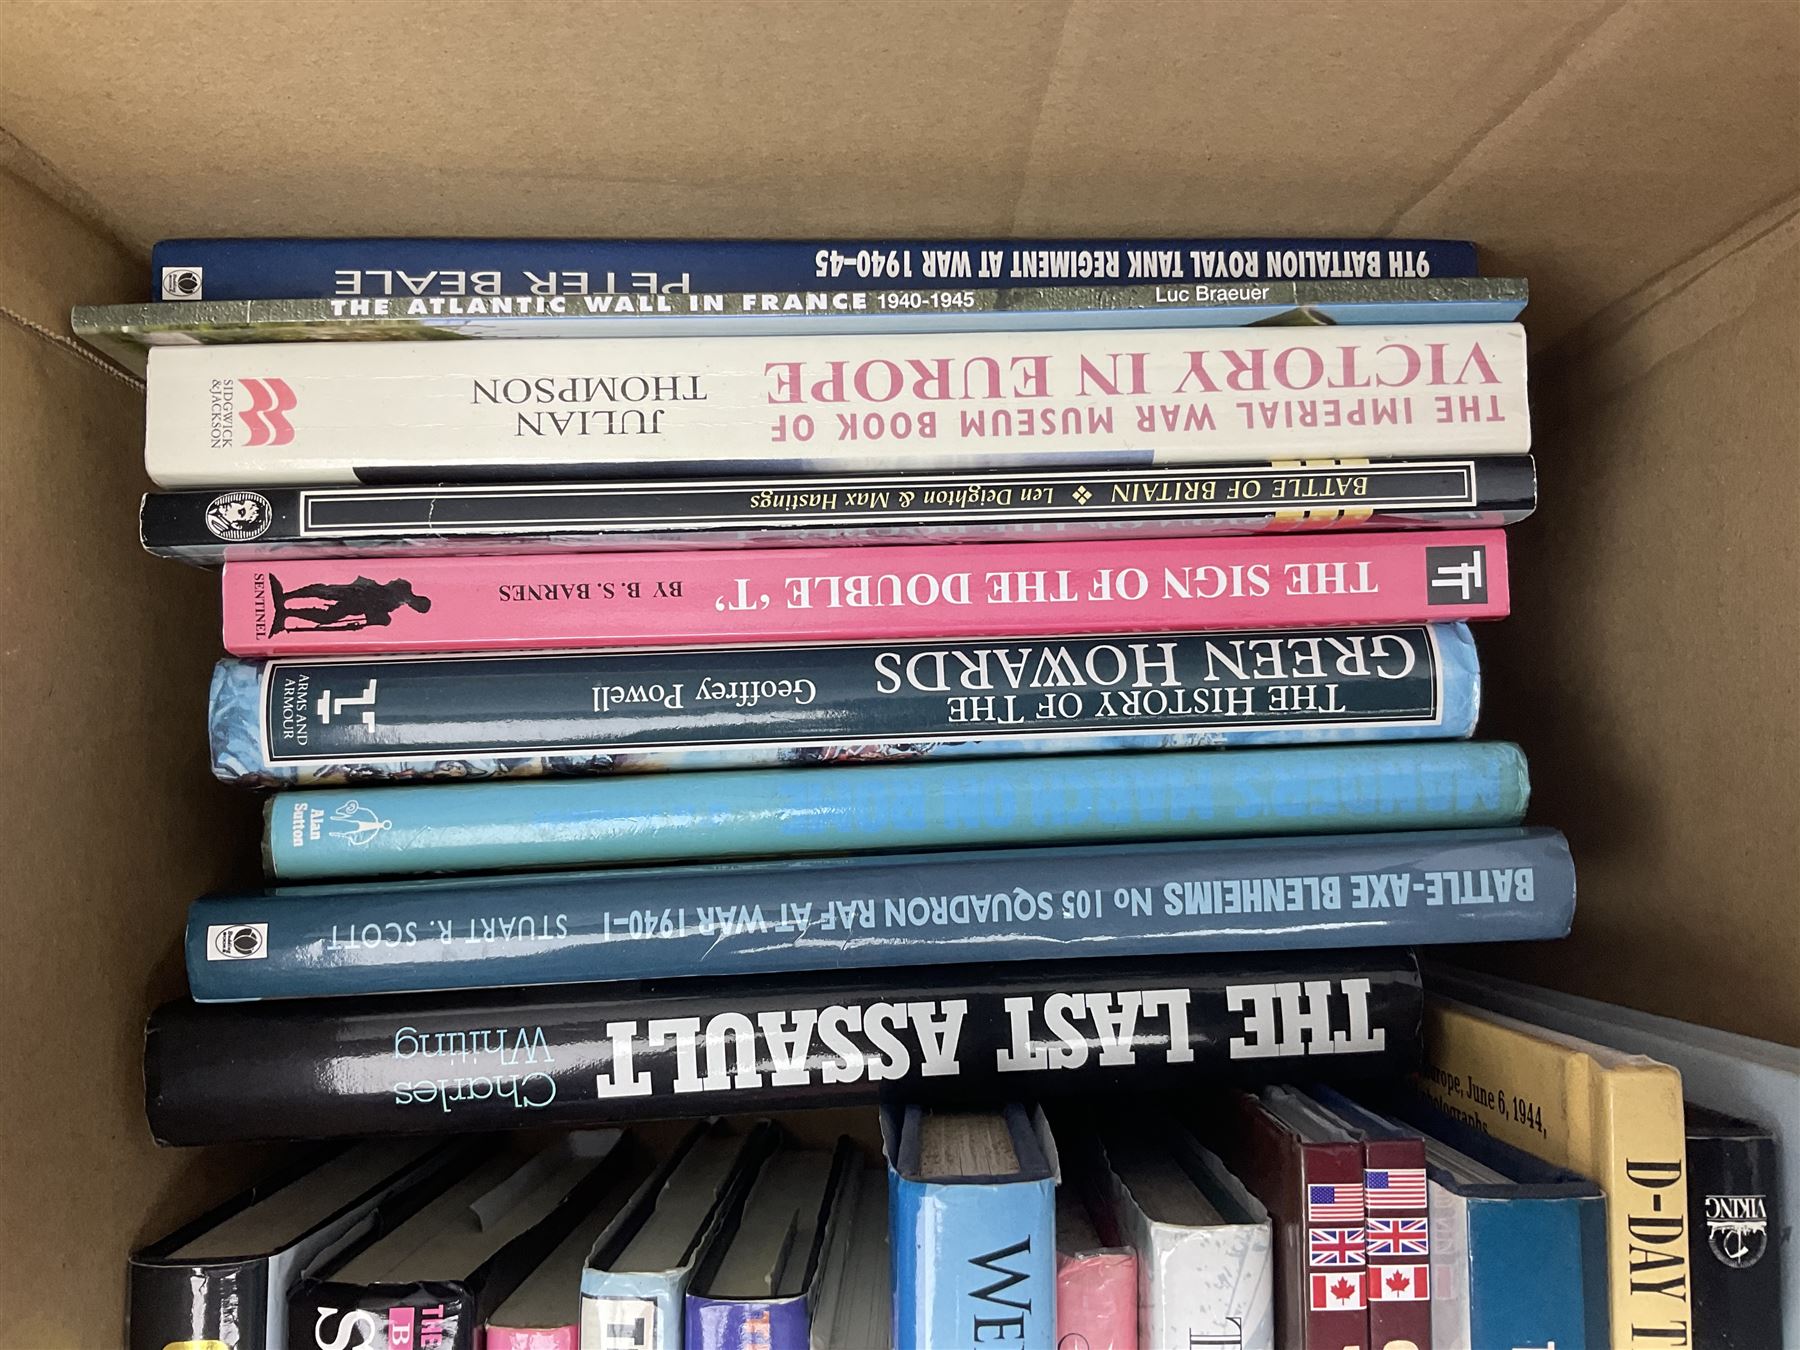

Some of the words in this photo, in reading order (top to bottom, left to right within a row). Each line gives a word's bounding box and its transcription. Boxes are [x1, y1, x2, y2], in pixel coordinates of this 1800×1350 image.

[921, 250, 972, 278] WAR
[978, 250, 1003, 278] AT
[1010, 250, 1119, 278] REGIMENT
[1127, 251, 1184, 278] TANK
[1190, 251, 1259, 278] ROYAL
[1267, 251, 1381, 278] BATTALION
[1388, 251, 1430, 278] 9TH
[335, 270, 501, 296] BEALE
[523, 271, 690, 296] PETER
[1155, 285, 1189, 303] Luc
[1195, 284, 1270, 302] Braeuer
[331, 298, 389, 317] THE
[407, 296, 566, 316] ATLANTIC
[584, 294, 672, 314] WALL
[690, 293, 724, 312] IN
[743, 292, 867, 311] FRANCE
[877, 290, 976, 309] 1940-1945
[763, 354, 1055, 406] EUROPE
[1075, 352, 1152, 397] IN
[1172, 341, 1503, 395] VICTORY
[471, 374, 708, 406] THOMPSON
[209, 378, 222, 450] &JACKSON
[222, 378, 234, 449] SIDGWICK
[515, 408, 665, 438] JULIAN
[960, 405, 1114, 438] MUSEUM
[1135, 402, 1217, 433] WAR
[1236, 396, 1412, 430] IMPERIAL
[1436, 394, 1505, 423] THE
[771, 413, 815, 443] OF
[837, 410, 937, 441] BOOK
[750, 488, 837, 513] Hastings
[844, 490, 890, 510] Max
[899, 490, 915, 508] &
[923, 484, 1012, 509] Deighton
[1020, 486, 1054, 505] Len
[1111, 480, 1216, 504] BRITAIN
[1227, 479, 1262, 501] OF
[1272, 475, 1370, 499] BATTLE
[499, 582, 590, 603] BARNES
[596, 582, 616, 602] S.
[625, 581, 641, 601] B.
[655, 580, 684, 599] BY
[785, 571, 973, 610] DOUBLE
[985, 569, 1079, 604] THE
[1088, 567, 1150, 602] OF
[1161, 564, 1270, 600] SIGN
[1284, 560, 1380, 596] THE
[253, 572, 265, 641] SENTINEL
[874, 641, 1183, 694] HOWARDS
[1205, 634, 1417, 683] GREEN
[296, 674, 310, 711] ARMS
[591, 682, 684, 713] Powell
[695, 676, 816, 707] Geoffrey
[1035, 692, 1084, 719] OF
[1095, 686, 1255, 719] HISTORY
[1268, 684, 1346, 714] THE
[282, 678, 296, 740] ARMOUR
[947, 695, 1025, 724] THE
[296, 714, 308, 746] AND
[292, 803, 305, 847] Sutton
[311, 808, 323, 840] Alan
[1114, 887, 1152, 917] No
[1164, 876, 1340, 916] BLENHEIMS
[1352, 867, 1534, 909] BATTLE-AXE
[697, 903, 762, 937] WAR
[776, 901, 812, 934] AT
[822, 898, 875, 931] RAF
[885, 886, 1053, 928] SQUADRON
[1062, 889, 1103, 921] 105
[327, 920, 418, 951] SCOTT
[430, 918, 452, 946] R.
[465, 912, 568, 945] STUART
[997, 988, 1195, 1072] LAST
[1225, 978, 1385, 1059] THE
[394, 1025, 555, 1065] Whiting
[596, 999, 967, 1099] ASSAULT
[394, 1072, 557, 1113] Charles
[1425, 1064, 1464, 1097] urope,
[1466, 1075, 1495, 1111] June
[1498, 1090, 1509, 1121] 6,
[1513, 1095, 1547, 1139] 1944,
[1705, 1197, 1767, 1218] VIKING
[1625, 1158, 1687, 1303] D-DAY
[967, 1234, 1032, 1350] WE
[606, 1317, 645, 1350] T
[1631, 1320, 1687, 1350] T
